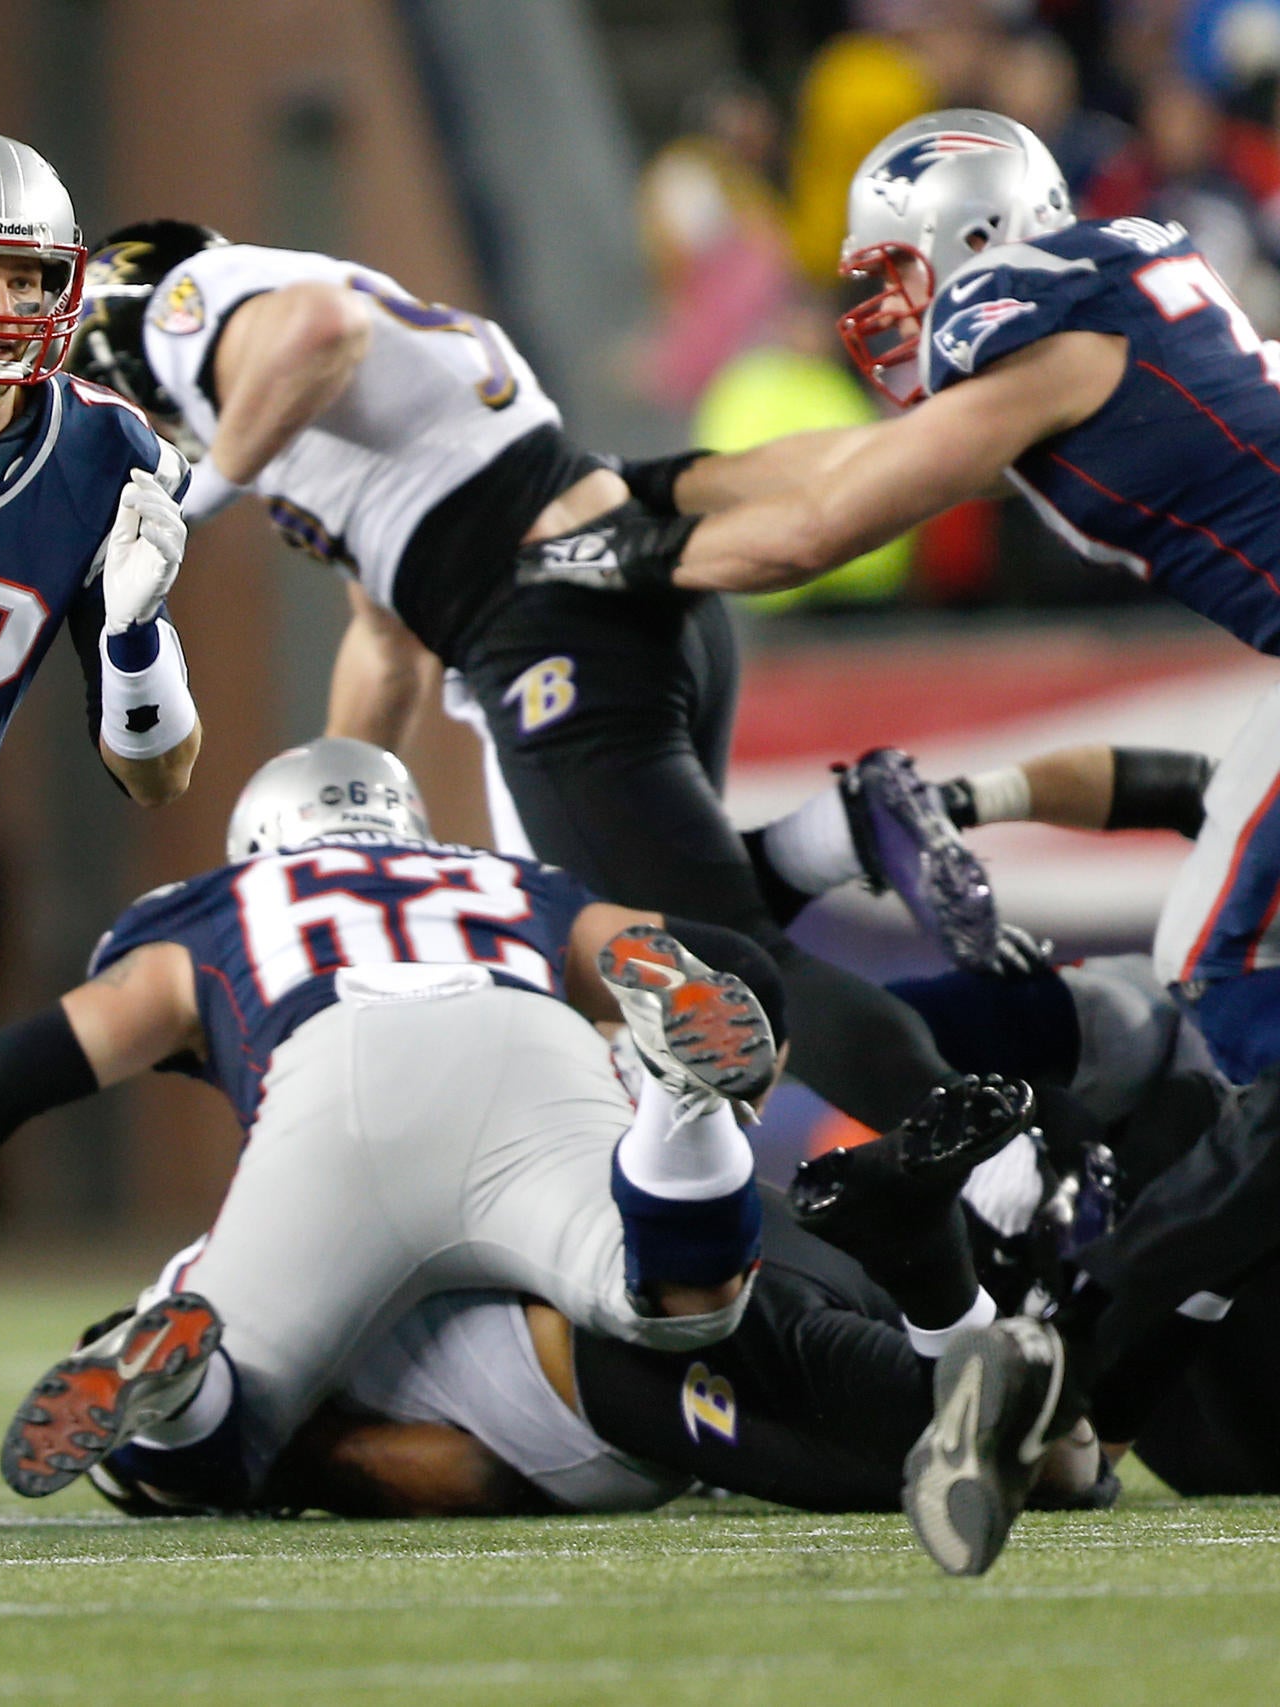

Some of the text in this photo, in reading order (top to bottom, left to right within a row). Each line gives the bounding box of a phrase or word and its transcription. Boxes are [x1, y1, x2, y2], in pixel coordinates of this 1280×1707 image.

[1131, 252, 1280, 393] 7
[500, 655, 577, 734] B
[230, 846, 557, 1007] 62
[681, 1360, 738, 1445] B
